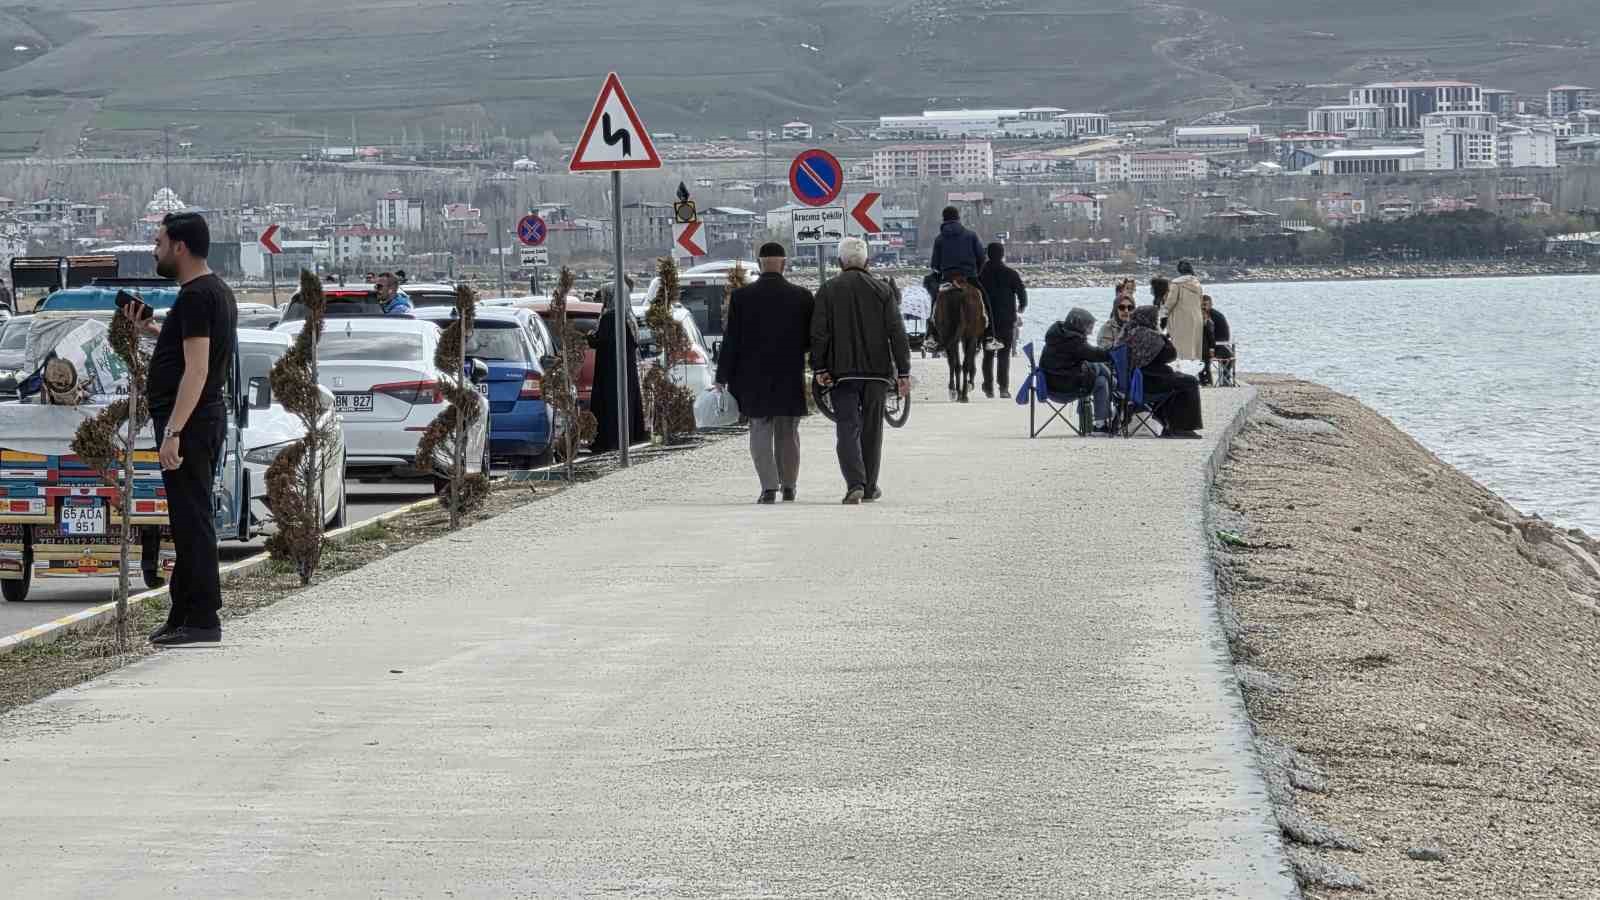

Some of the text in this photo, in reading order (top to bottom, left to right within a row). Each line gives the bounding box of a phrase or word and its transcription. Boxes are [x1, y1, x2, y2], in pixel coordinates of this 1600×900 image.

[353, 396, 371, 407] 827
[63, 509, 102, 520] 65 ADA
[75, 521, 95, 532] 951
